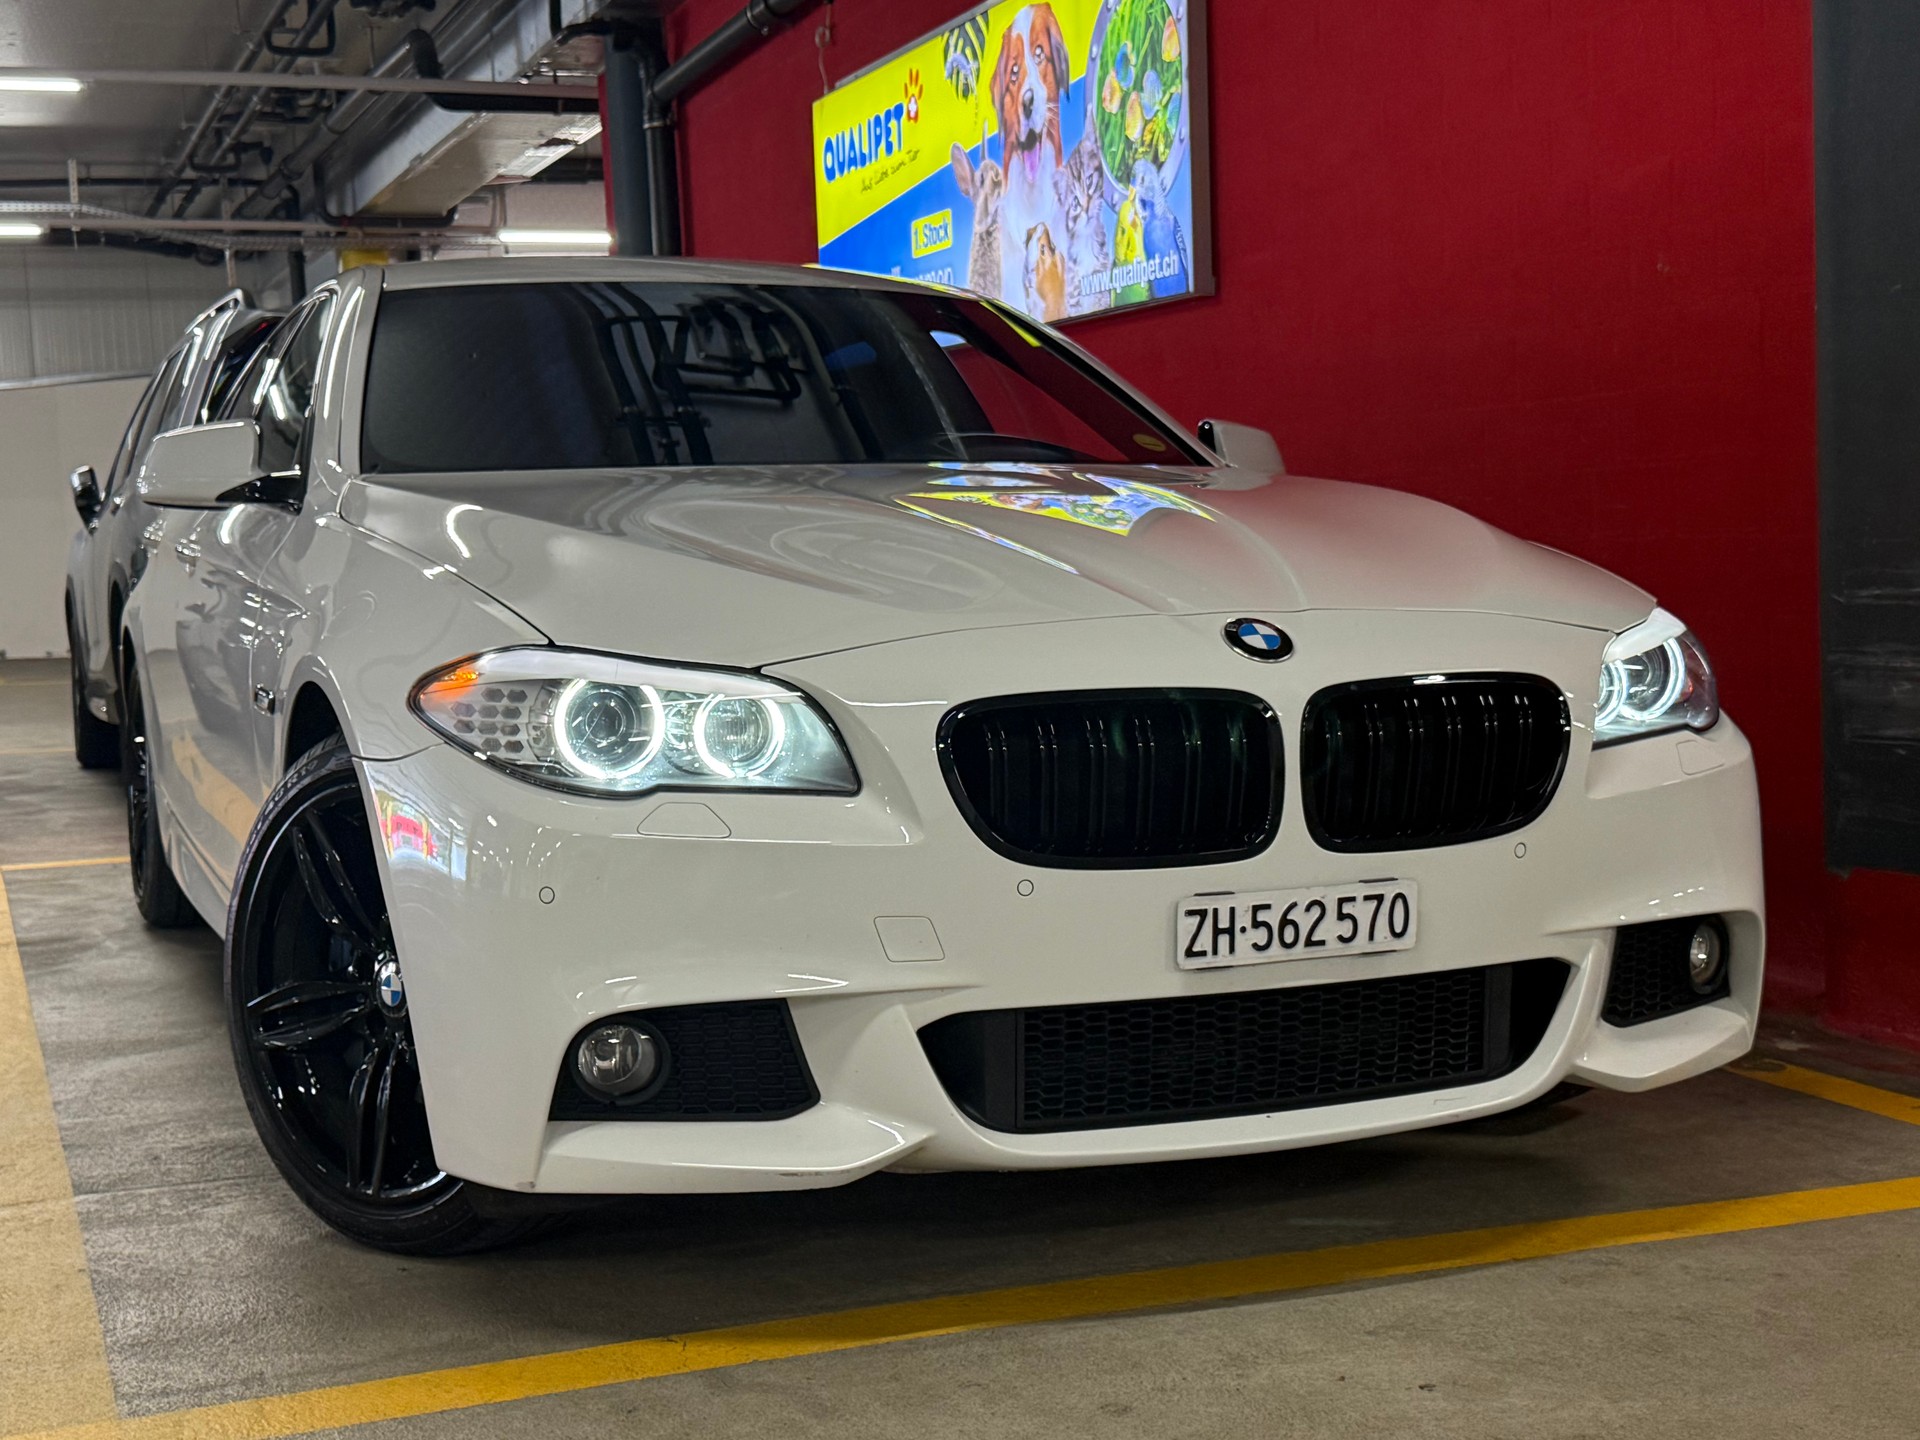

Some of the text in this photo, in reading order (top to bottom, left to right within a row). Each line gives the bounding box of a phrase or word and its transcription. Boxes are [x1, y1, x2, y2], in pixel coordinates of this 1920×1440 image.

[822, 102, 904, 184] QUALIPET
[922, 216, 950, 249] Stock
[1080, 249, 1179, 296] www.qualipet.ch
